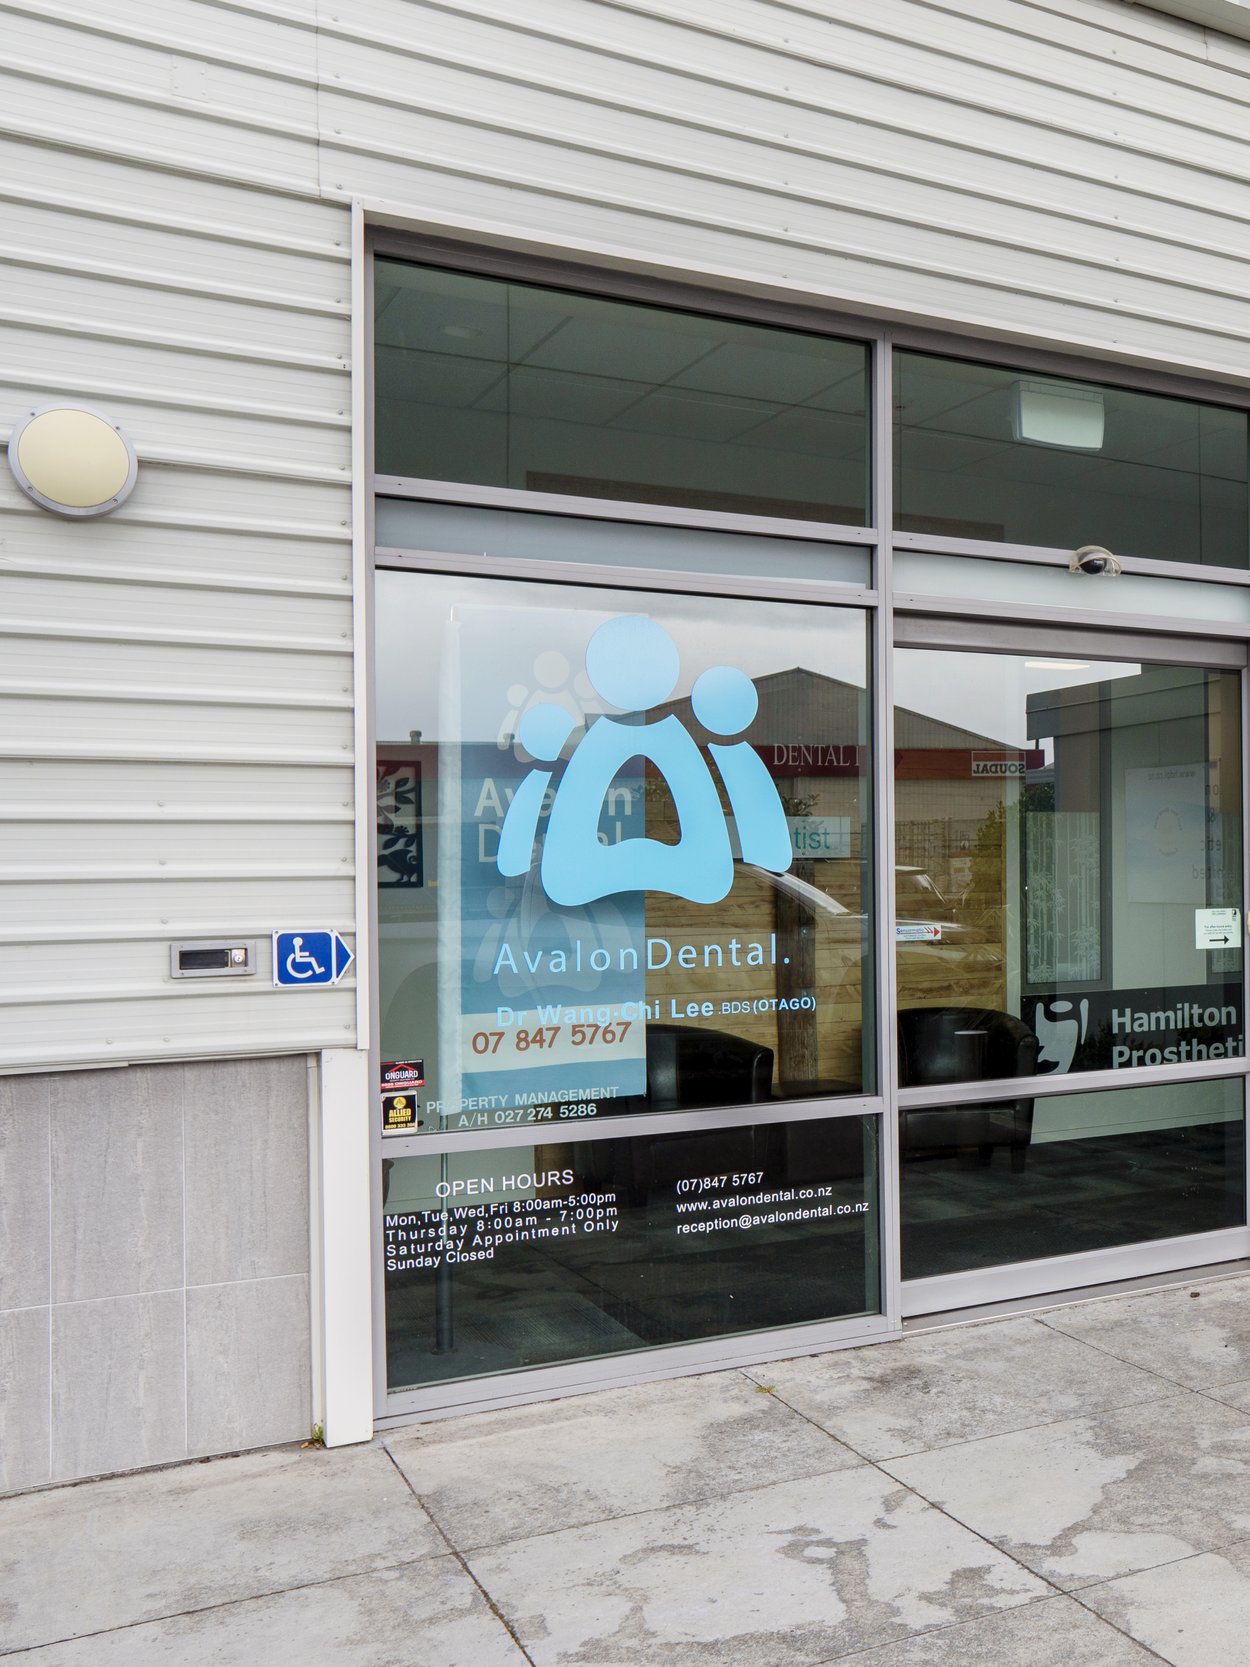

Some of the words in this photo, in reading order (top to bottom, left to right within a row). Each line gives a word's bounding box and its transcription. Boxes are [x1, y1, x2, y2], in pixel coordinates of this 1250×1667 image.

[773, 744, 851, 766] DENTAL
[495, 1005, 527, 1028] Dr
[670, 998, 714, 1019] Lee
[1111, 1002, 1237, 1034] Hamilton
[471, 1030, 505, 1055] 07
[515, 1026, 561, 1052] 847
[570, 1021, 632, 1046] 5767
[385, 1070, 419, 1080] ONGUARD
[389, 1108, 412, 1118] ALLIED
[426, 1094, 509, 1114] PRPERTY
[514, 1086, 619, 1106] MANAGEMENT
[458, 1112, 488, 1128] A/H
[494, 1109, 523, 1124] 027
[526, 1106, 552, 1121] 274
[559, 1103, 598, 1118] 5286
[435, 1177, 494, 1198] OPEN
[502, 1169, 574, 1191] HOURS
[676, 1175, 727, 1195] (07)847
[732, 1171, 764, 1186] 5767
[513, 1192, 617, 1213] 8:00am-5:00pm
[676, 1186, 833, 1213] www.avalondental.co.nz
[386, 1223, 468, 1242] Thursday
[476, 1215, 538, 1231] 8:00am
[559, 1206, 618, 1222] 7:00pm
[676, 1202, 870, 1235] reception@avalondental.co.nz
[386, 1238, 464, 1257] Saturday
[472, 1222, 577, 1248] Appointment
[583, 1219, 619, 1233] Only
[386, 1254, 442, 1271] Sunday
[446, 1247, 494, 1264] Closed
